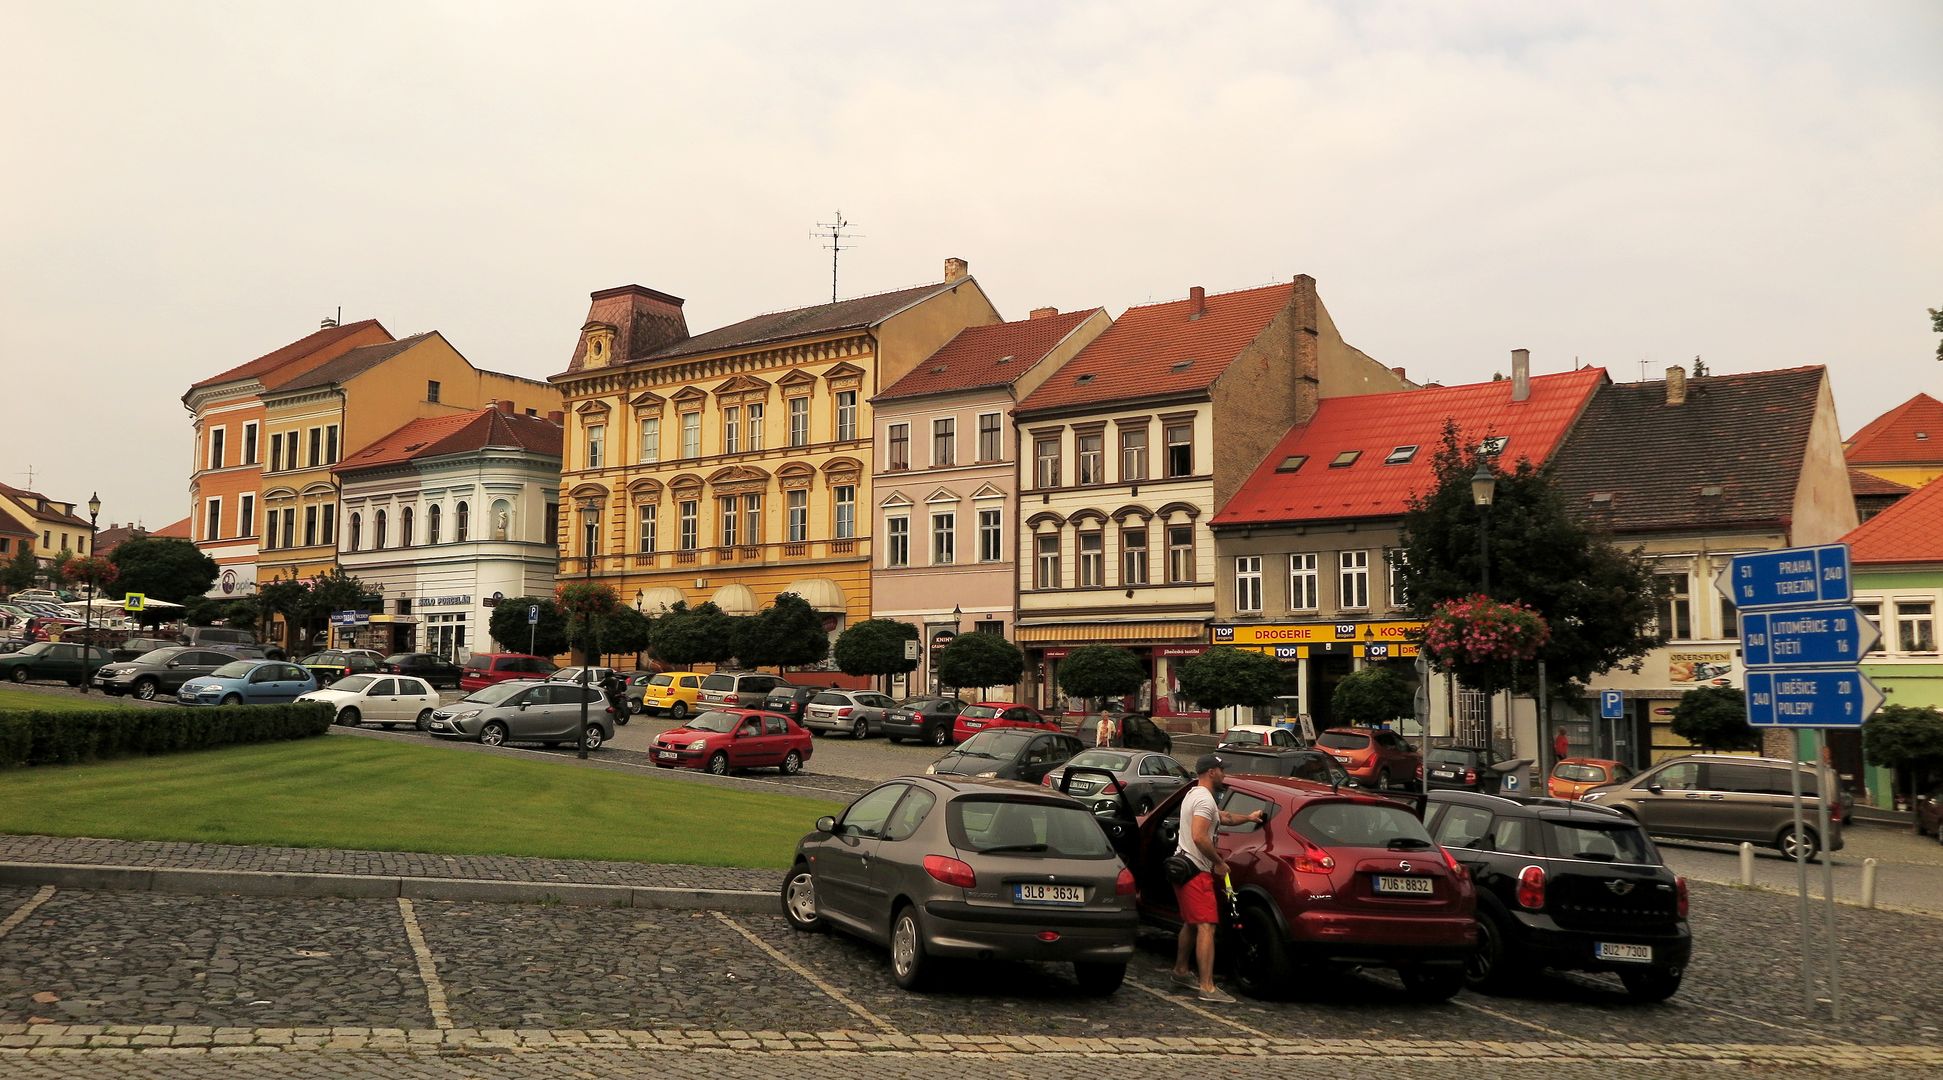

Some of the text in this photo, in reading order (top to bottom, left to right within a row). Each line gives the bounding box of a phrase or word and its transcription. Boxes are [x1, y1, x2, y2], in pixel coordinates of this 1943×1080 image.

[1741, 560, 1813, 578] 51 PRAHA
[1823, 566, 1843, 580] 240
[1743, 577, 1815, 597] 16 TEREZÍN
[1336, 625, 1354, 633] TOP
[1772, 616, 1847, 634] LITOMĚŘICE 20
[1216, 628, 1233, 636] TOP
[1255, 629, 1311, 639] DROGERIE
[1748, 633, 1765, 646] 240
[1276, 648, 1296, 657] TOP
[1774, 638, 1849, 655] ŠTĚTÍ 16
[1776, 678, 1851, 694] LIBĚŠICE 20
[1607, 693, 1619, 709] P
[1752, 692, 1769, 705] 240
[1778, 702, 1852, 715] POLEPY 9
[1507, 775, 1517, 789] P
[1381, 878, 1429, 891] 7U6 8832
[1024, 886, 1079, 900] 3L8 3634
[1602, 944, 1648, 957] 8U2 7300
